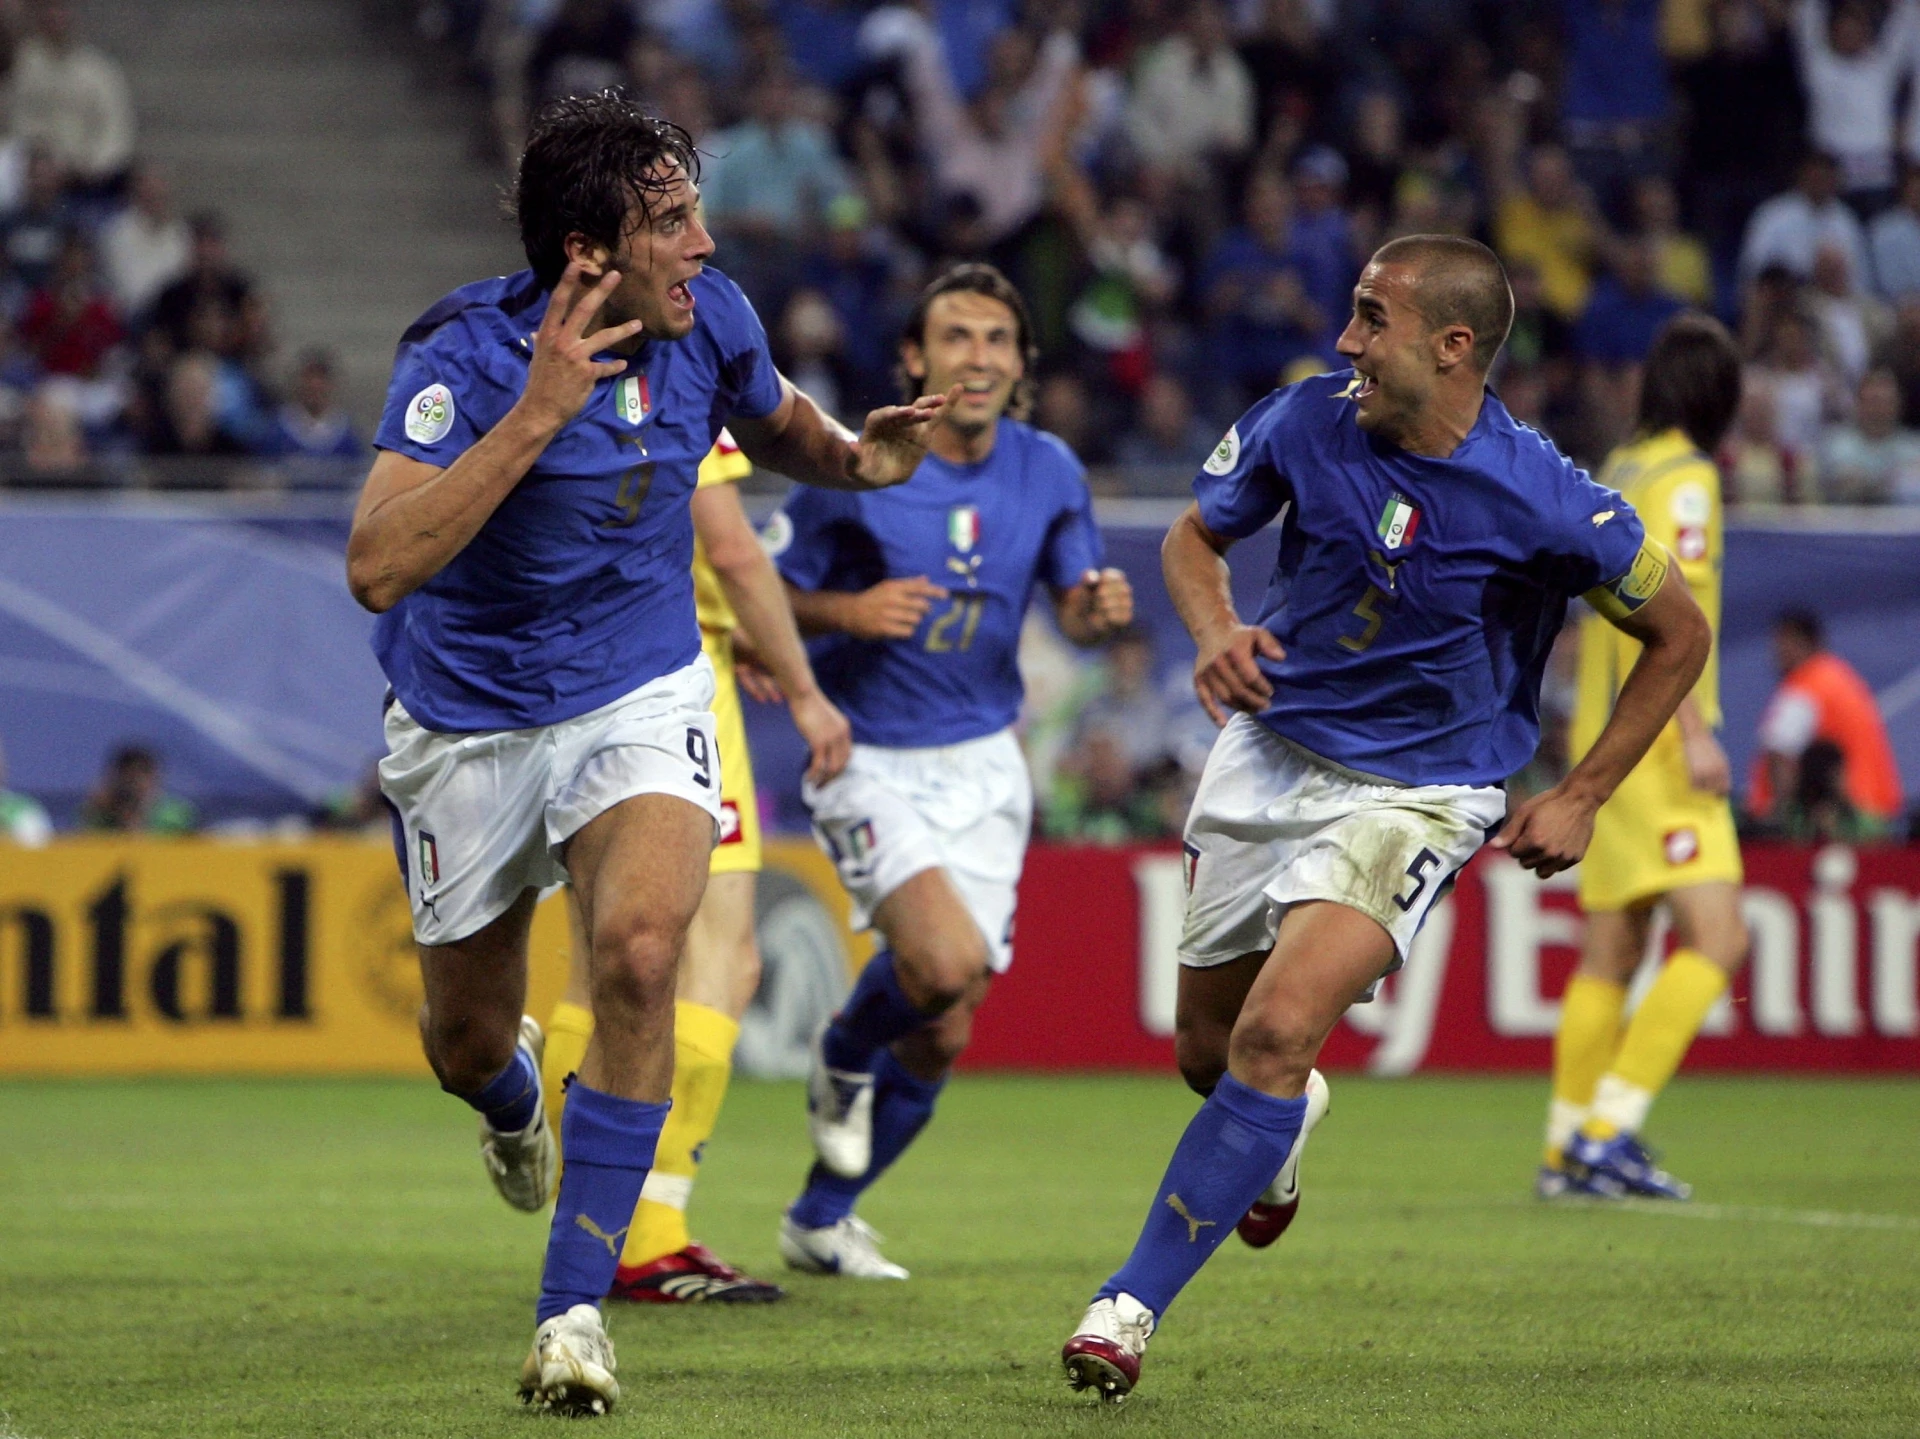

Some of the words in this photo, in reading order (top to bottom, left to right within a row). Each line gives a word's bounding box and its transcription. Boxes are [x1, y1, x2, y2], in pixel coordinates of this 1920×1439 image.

[603, 463, 656, 529] 9
[924, 595, 982, 652] 21
[1336, 585, 1382, 651] 5
[686, 727, 711, 788] 9
[1392, 847, 1441, 912] 5
